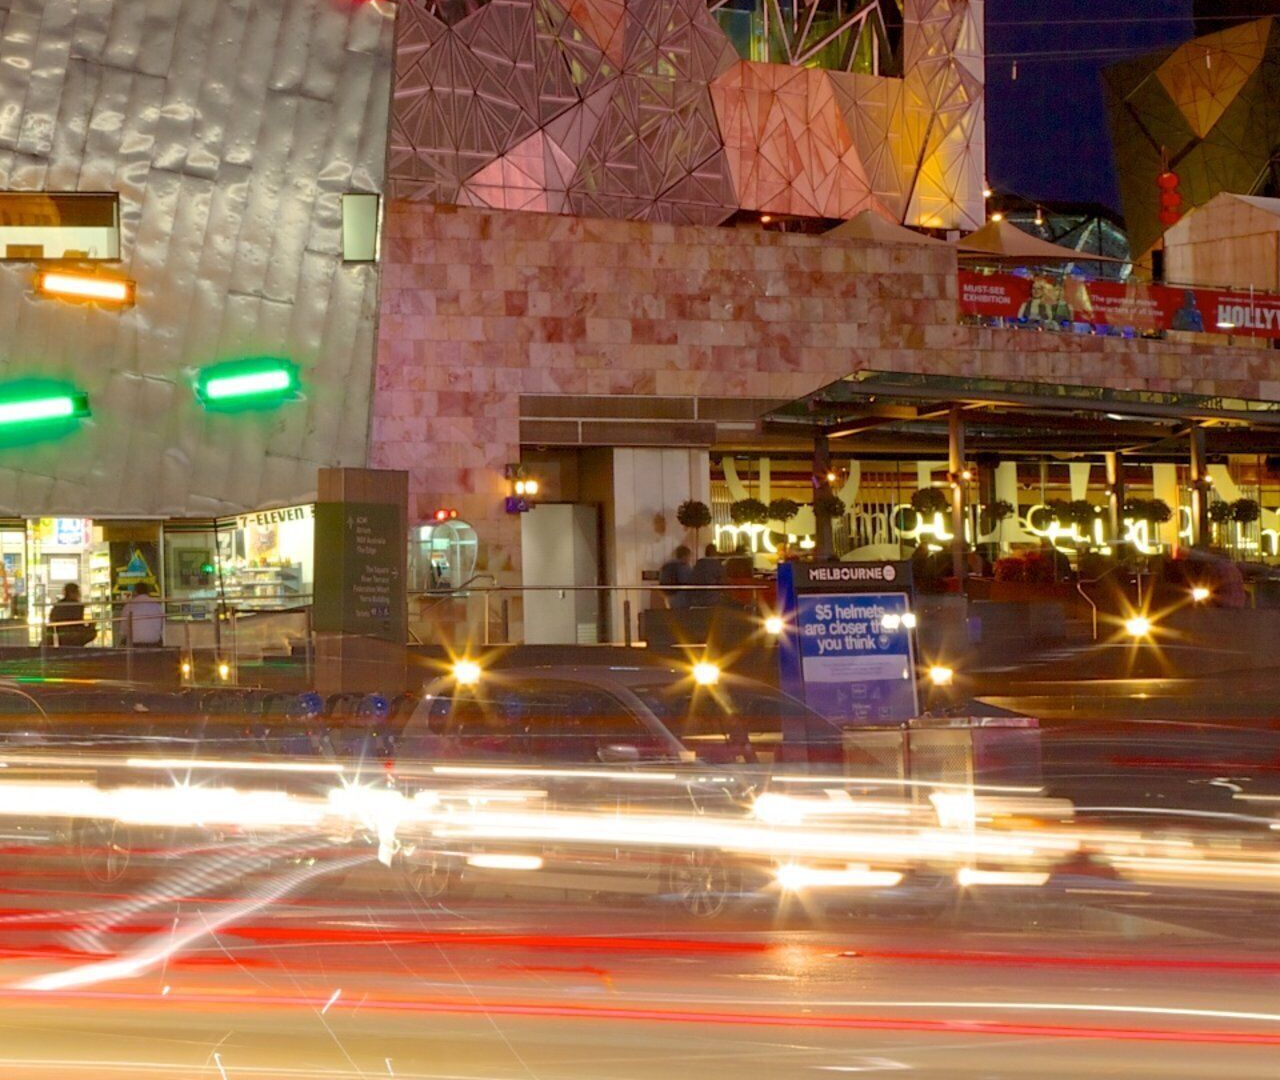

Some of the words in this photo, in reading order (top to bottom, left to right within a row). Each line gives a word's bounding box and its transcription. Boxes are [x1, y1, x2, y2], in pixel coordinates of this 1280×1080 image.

[963, 284, 1005, 295] MUST-SEE
[963, 293, 1011, 305] EXHIBITION
[1091, 294, 1105, 303] The
[1217, 304, 1280, 330] HOLLY
[809, 568, 883, 581] MELBOURNE
[815, 604, 833, 621] $5
[835, 603, 885, 620] helmets
[805, 623, 826, 636] are
[829, 620, 868, 635] closer
[817, 638, 842, 654] you
[844, 634, 877, 650] think
